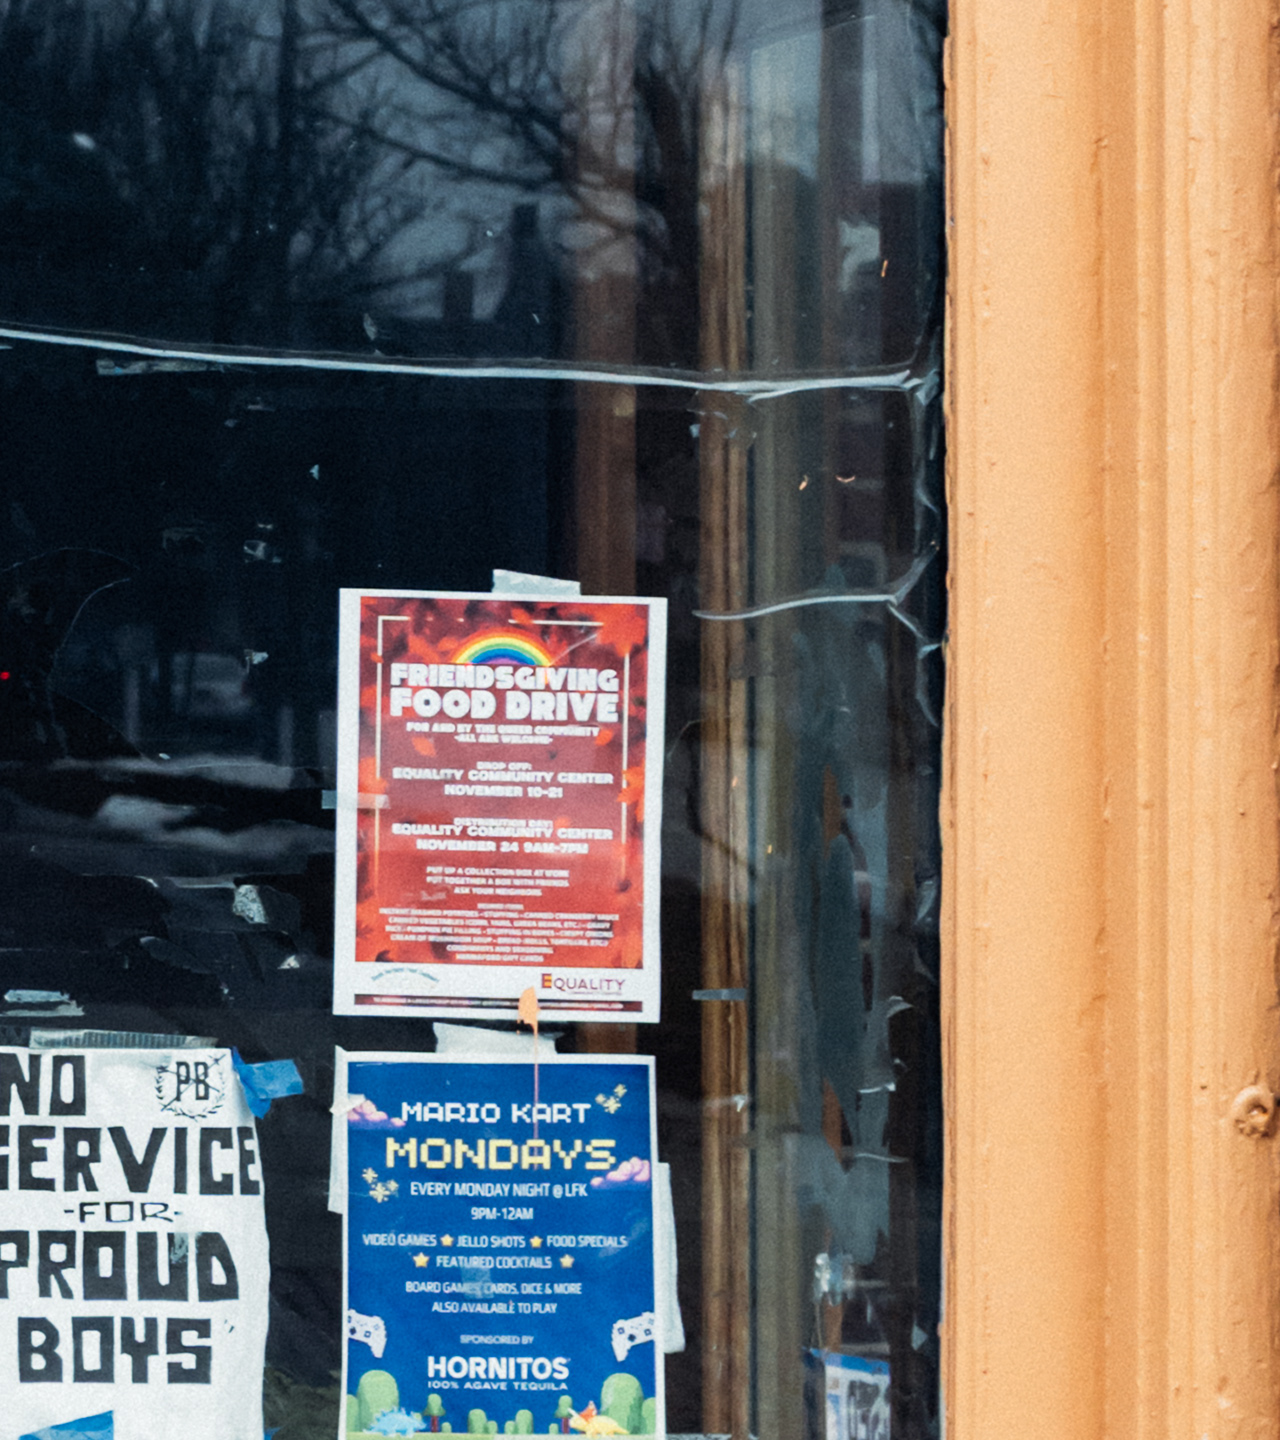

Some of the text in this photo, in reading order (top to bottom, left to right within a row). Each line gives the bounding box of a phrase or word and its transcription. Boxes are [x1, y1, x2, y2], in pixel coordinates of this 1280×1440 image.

[391, 662, 619, 691] FRIENDSGIVING
[390, 688, 619, 722] FOOD DRIVE
[445, 785, 523, 797] NOVEMBER
[404, 1102, 591, 1124] MARIO KART
[387, 1138, 616, 1169] MONDAYS
[411, 1182, 451, 1195] EVERY
[455, 1183, 510, 1197] MONDAY
[513, 1183, 550, 1197] NIGHT
[565, 1183, 587, 1197] LFK
[471, 1207, 533, 1220] 9PM-12AM
[428, 1356, 569, 1379] HORNITOS
